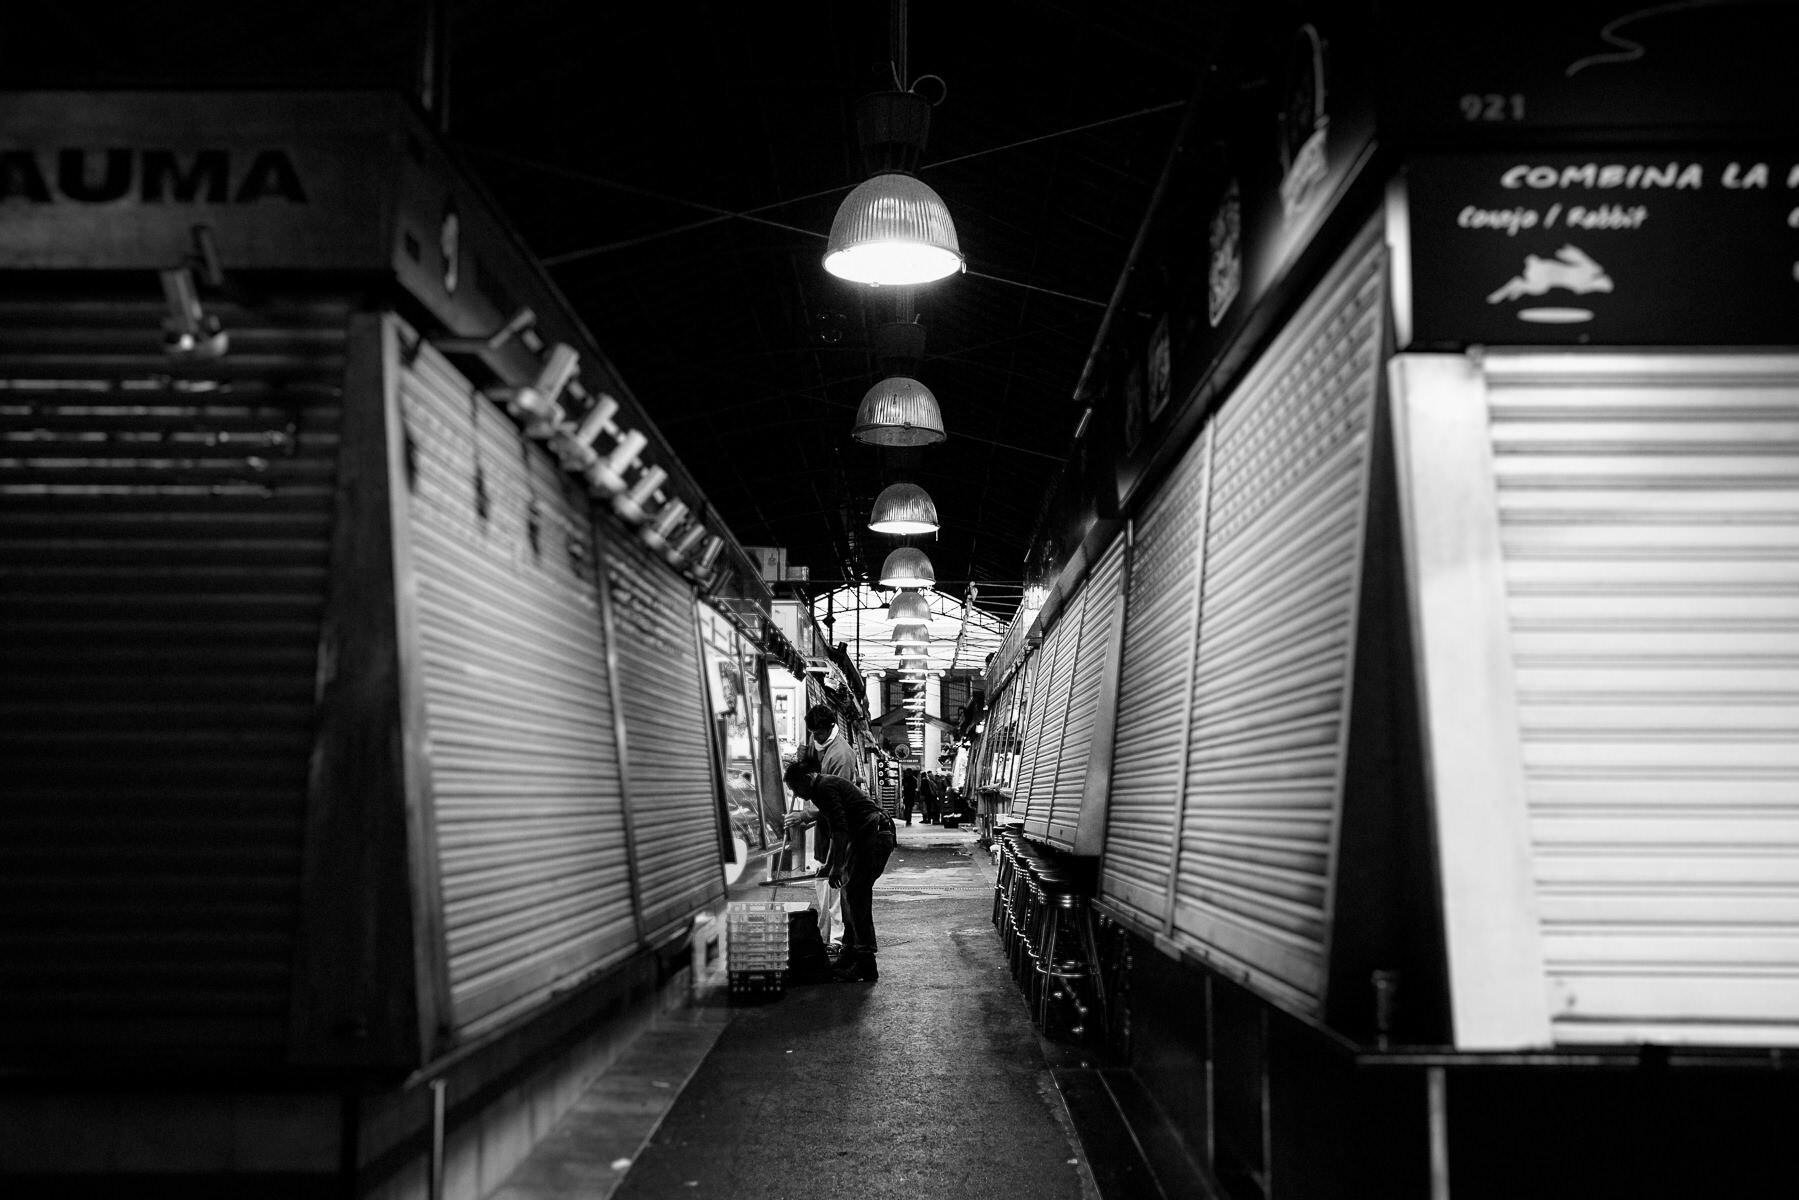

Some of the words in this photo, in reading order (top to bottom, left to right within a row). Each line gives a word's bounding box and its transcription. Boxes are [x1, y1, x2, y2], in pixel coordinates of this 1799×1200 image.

[1459, 93, 1526, 121] 921
[0, 148, 306, 203] AUMA
[1500, 162, 1704, 190] COMBINA
[1720, 160, 1770, 190] LA
[1565, 203, 1649, 230] Rabbit
